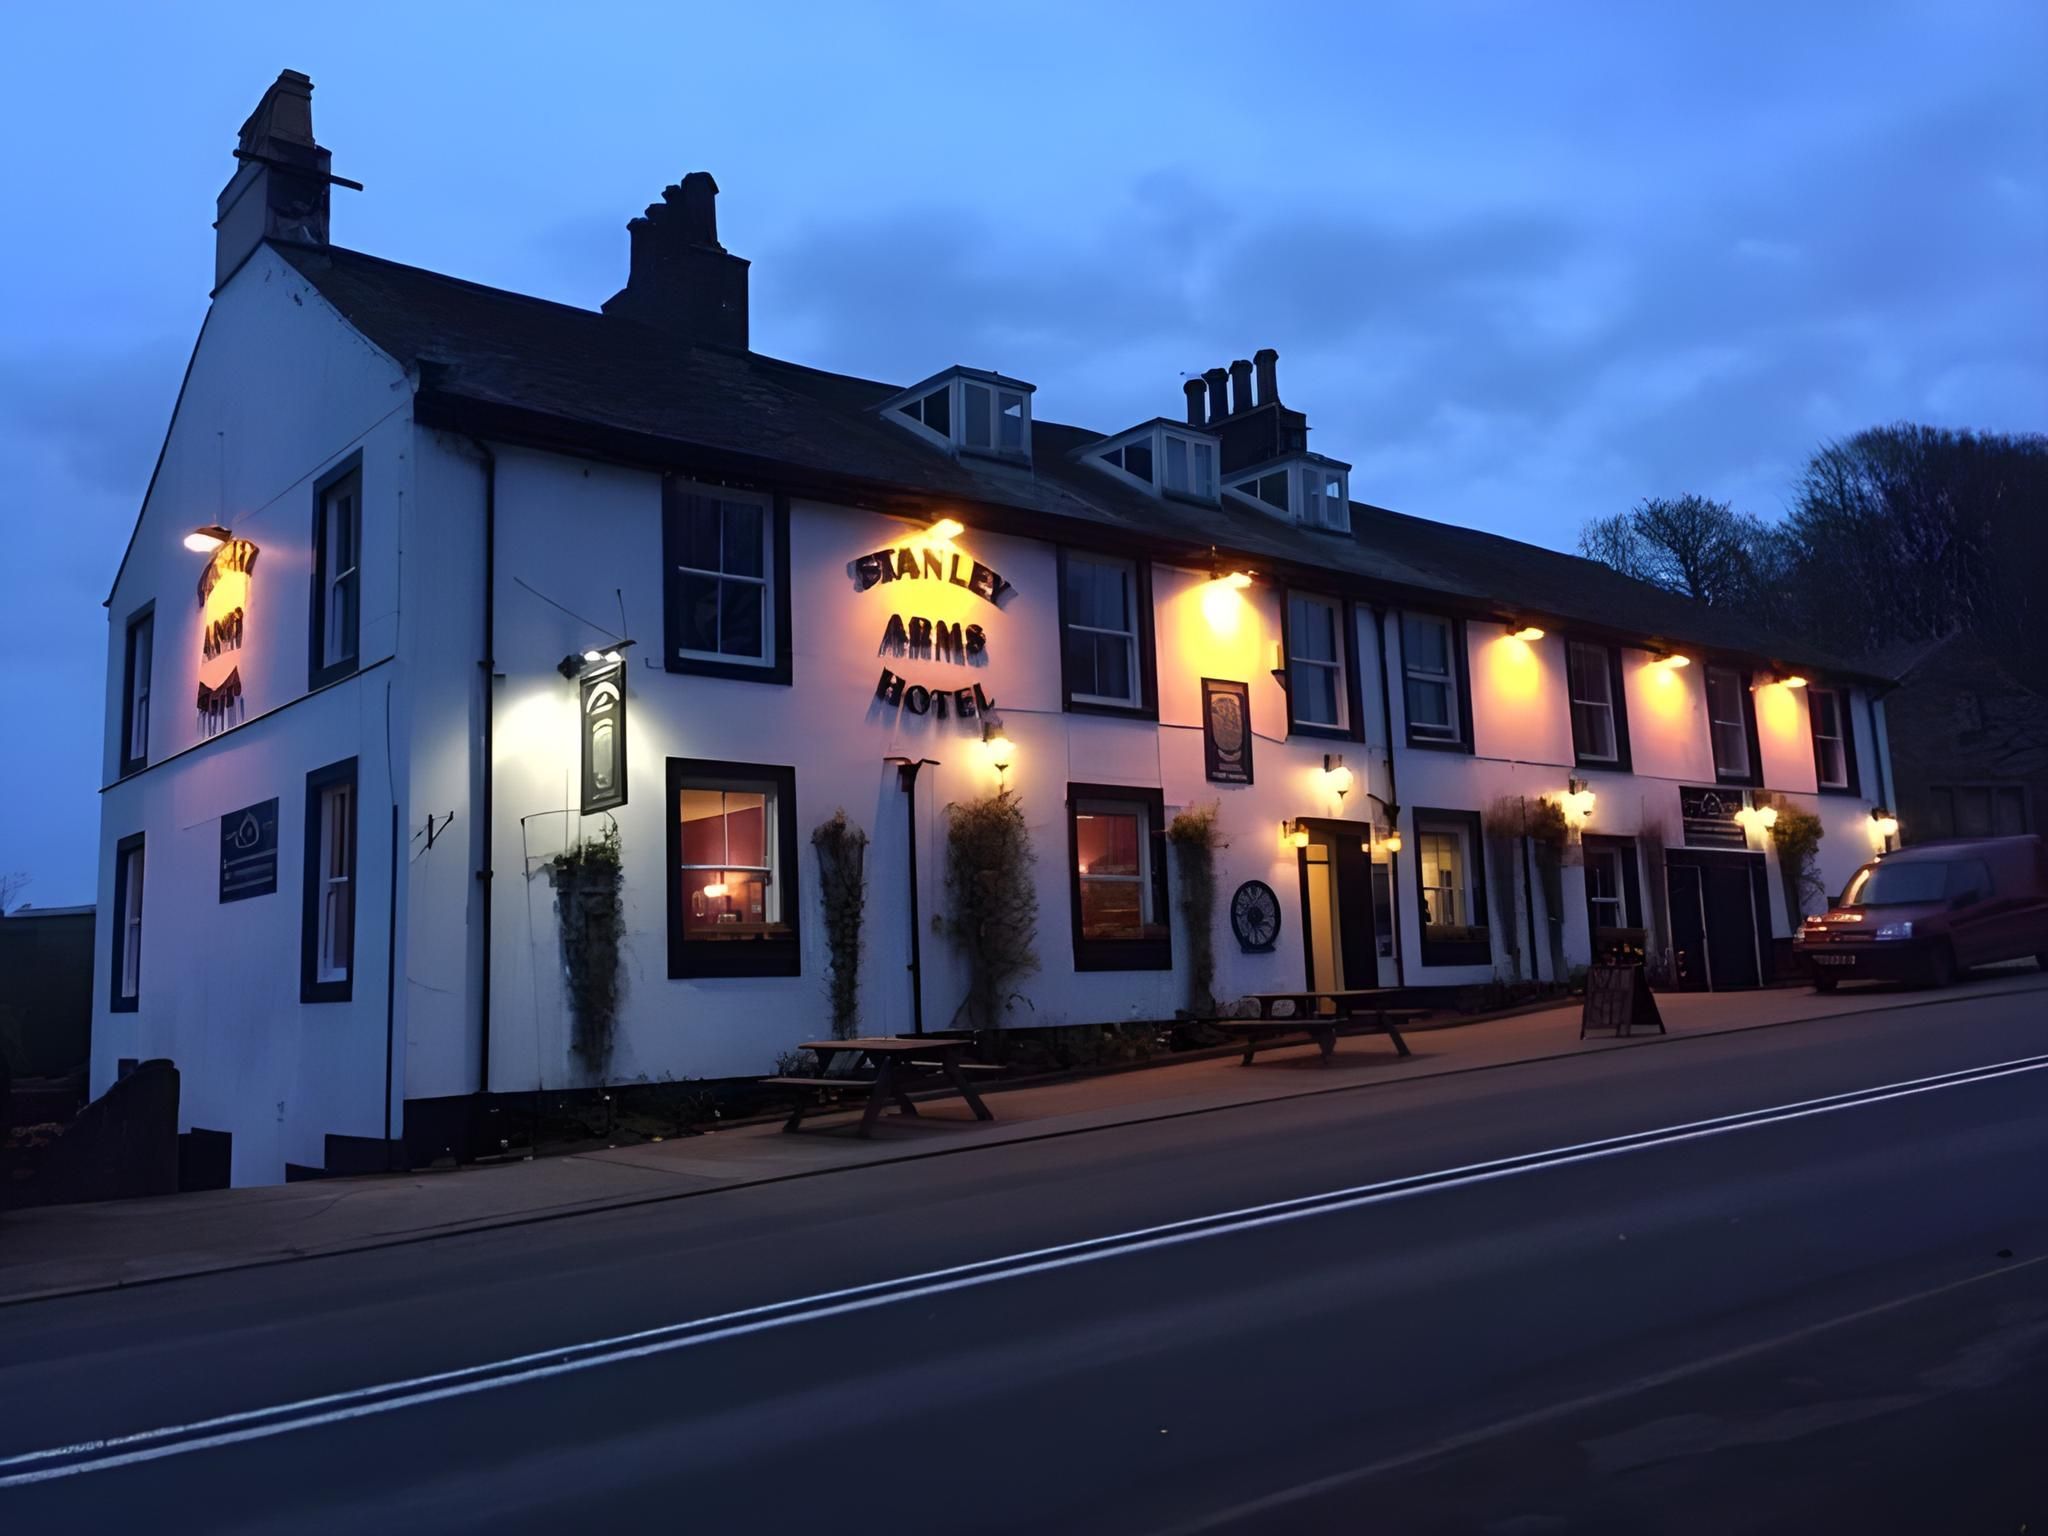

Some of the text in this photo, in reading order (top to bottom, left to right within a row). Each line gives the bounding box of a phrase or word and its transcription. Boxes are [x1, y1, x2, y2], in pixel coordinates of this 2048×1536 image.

[851, 548, 1013, 604] STANLEY
[879, 614, 986, 660] ARMS
[874, 667, 996, 719] HOTEL
